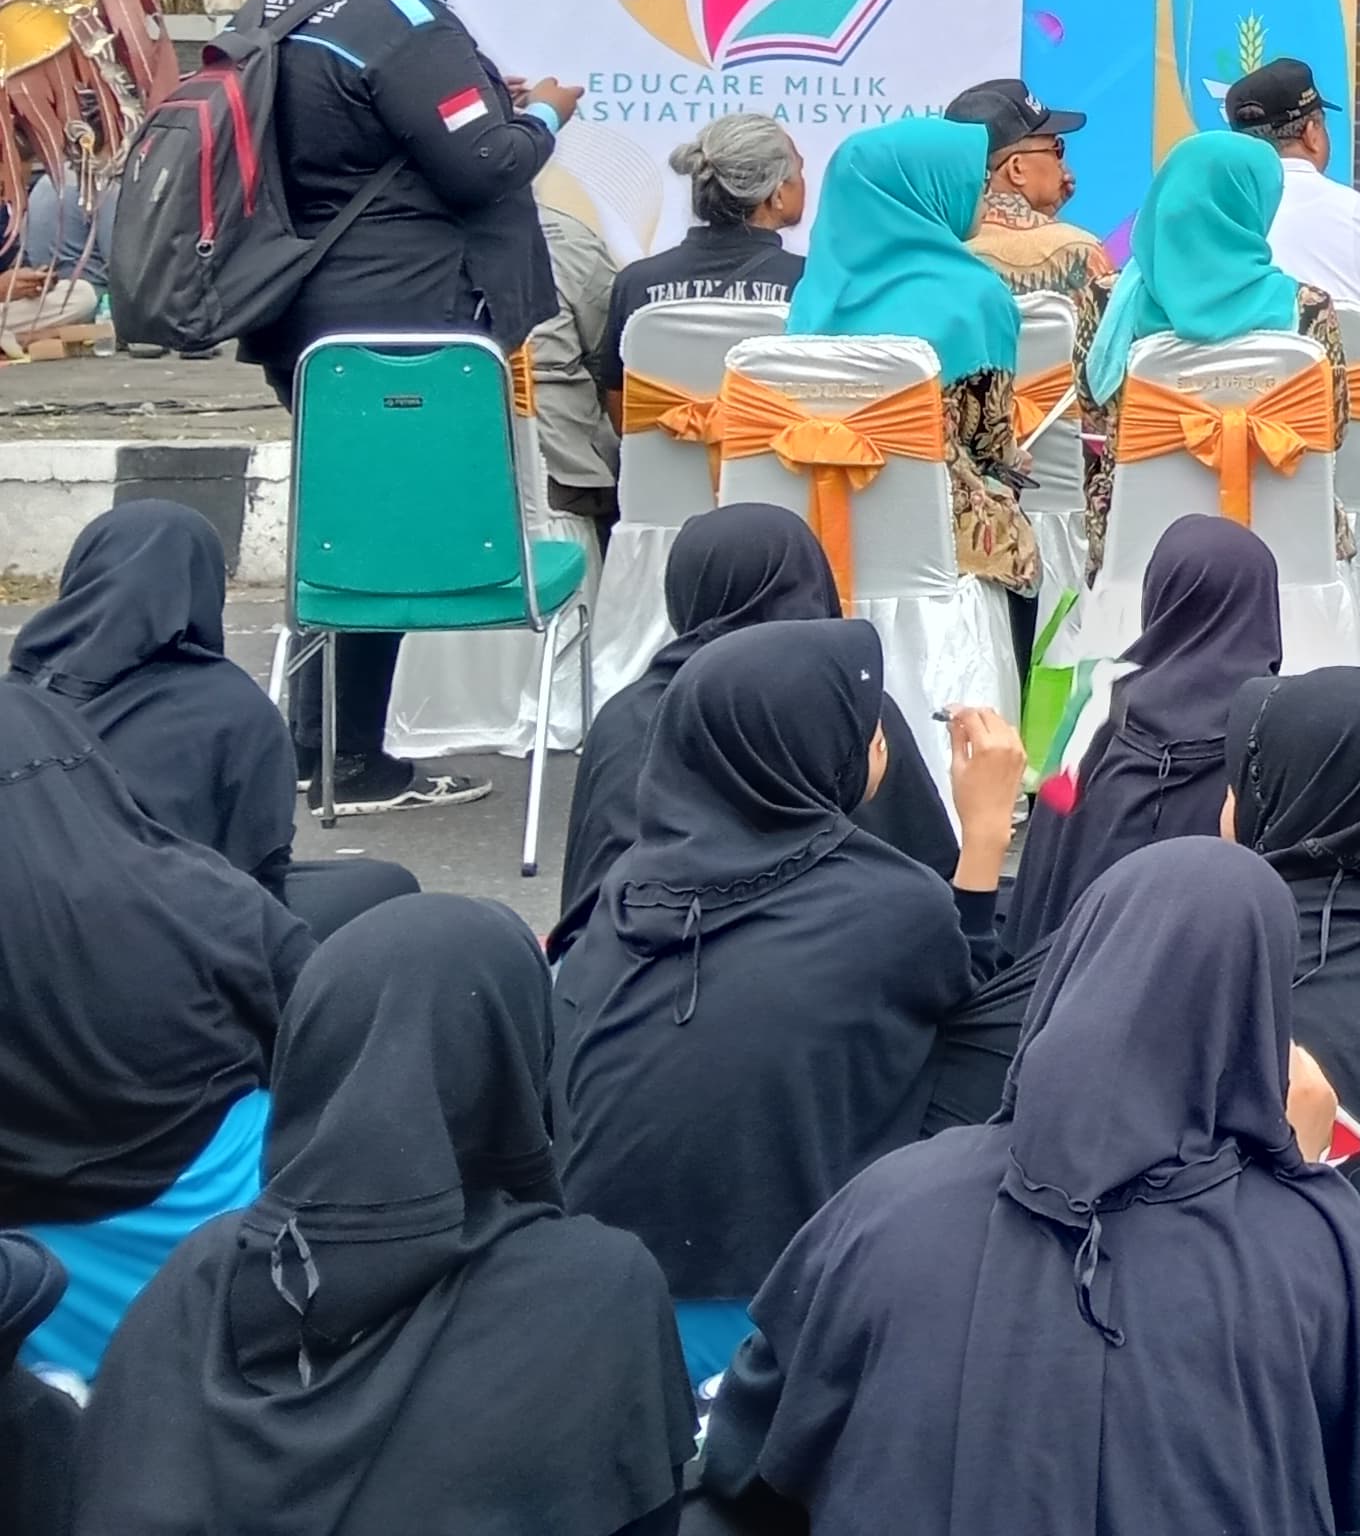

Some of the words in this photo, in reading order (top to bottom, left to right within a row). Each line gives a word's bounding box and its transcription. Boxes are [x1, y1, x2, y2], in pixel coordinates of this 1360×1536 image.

[588, 72, 765, 96] EDUCARE
[784, 75, 887, 97] MILIK
[646, 280, 689, 303] TEAM
[752, 281, 789, 303] SUCI
